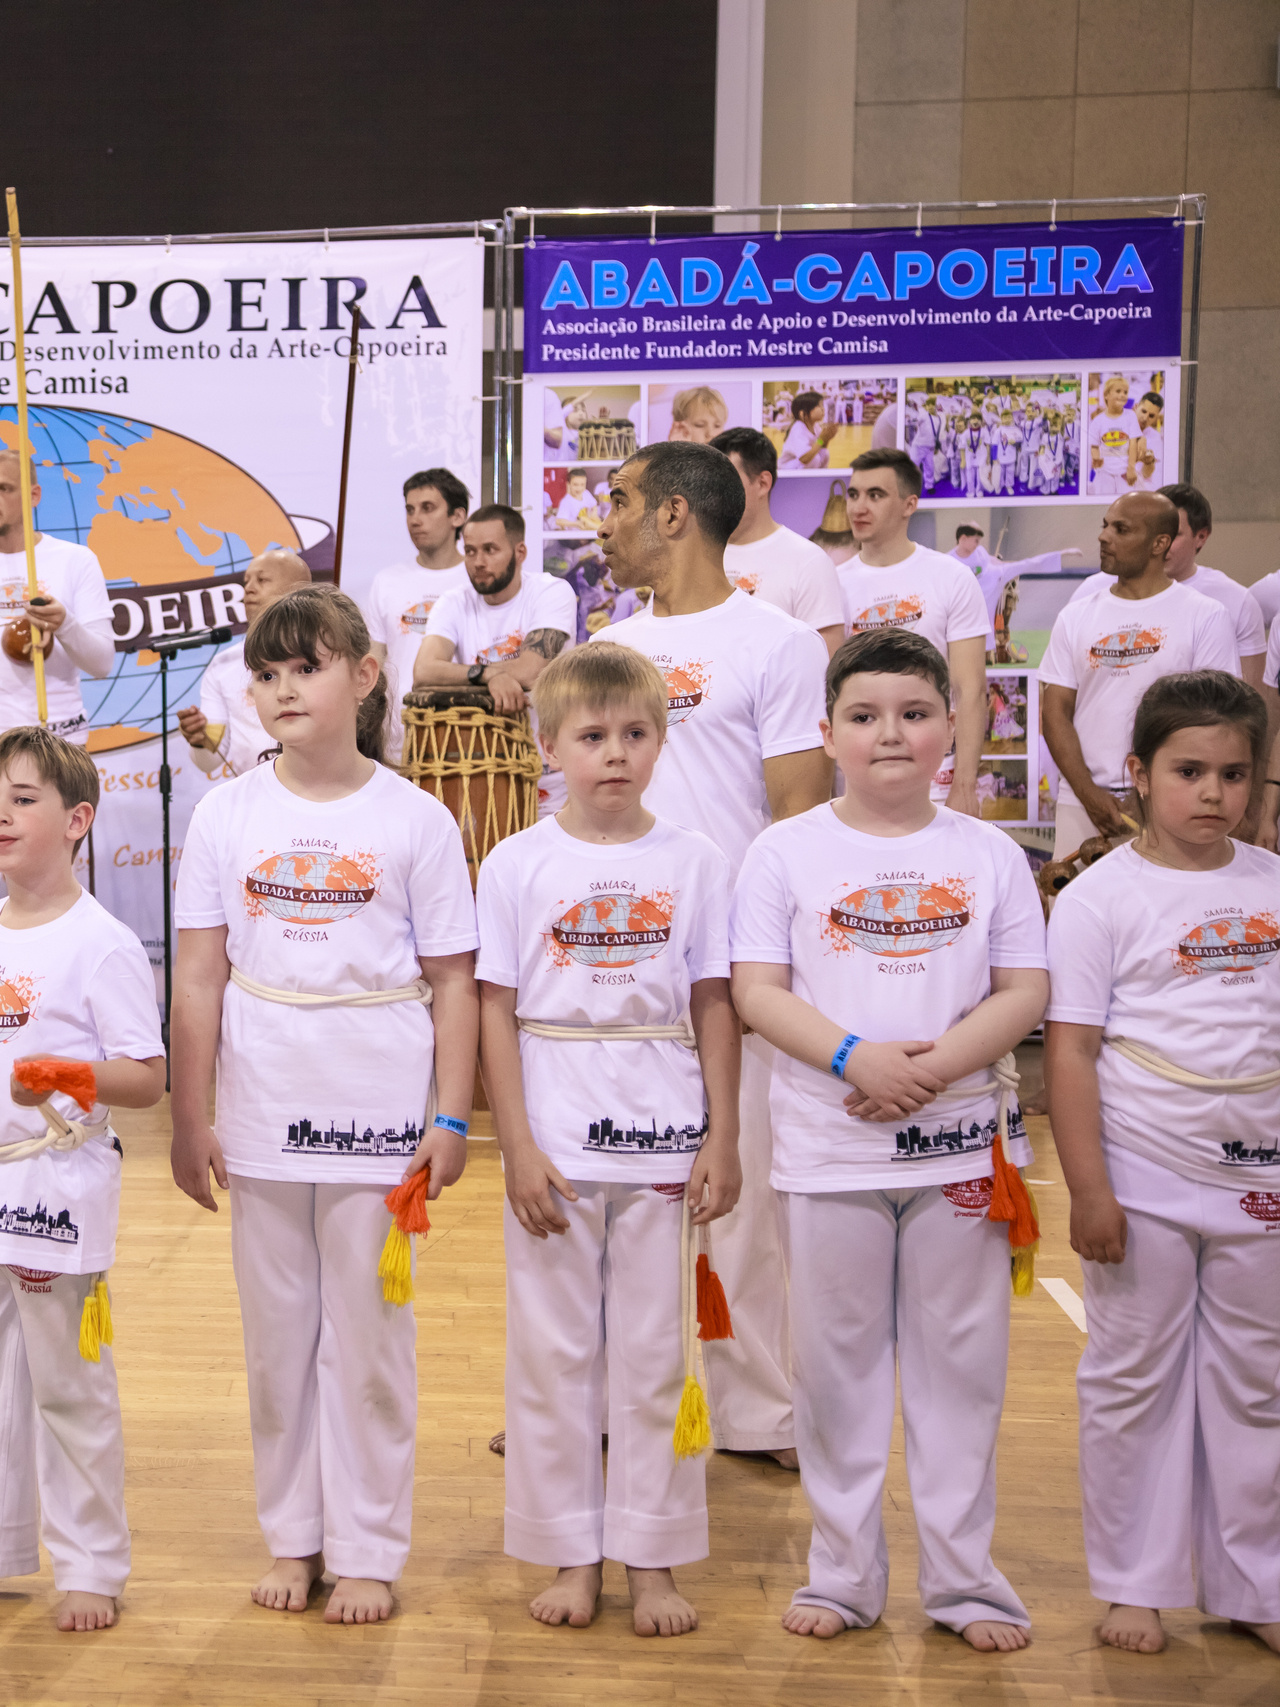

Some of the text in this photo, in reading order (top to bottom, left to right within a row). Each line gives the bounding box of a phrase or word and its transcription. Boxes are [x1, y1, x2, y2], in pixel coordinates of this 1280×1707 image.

[540, 241, 1154, 310] ABADÁ-CAPOEIRA
[542, 302, 1152, 337] Associação Brasileira de Apoio e Desenvolvimento da Arte-Capoeira
[0, 339, 221, 362] Desenvolvimento
[230, 338, 258, 359] da
[267, 335, 448, 364] Arte-Capoeira
[541, 335, 889, 362] Presidente Fundador: Mestre Camisa
[24, 367, 129, 396] Camisa
[290, 837, 338, 850] SAMARA
[875, 870, 926, 883] SAMARA
[252, 881, 366, 903] ABADÁ-CAPOEIRA
[589, 880, 636, 893] SAMARA
[1204, 907, 1244, 918] SAMARA
[838, 913, 963, 934] ABADÁ-CAPOEIRA
[282, 928, 330, 943] RÚSSIA
[558, 928, 668, 946] ABADÁ-CAPOEIRA
[877, 962, 926, 976] RÚSSIA
[591, 971, 636, 986] RÚSSIA
[19, 1281, 53, 1294] Russia
